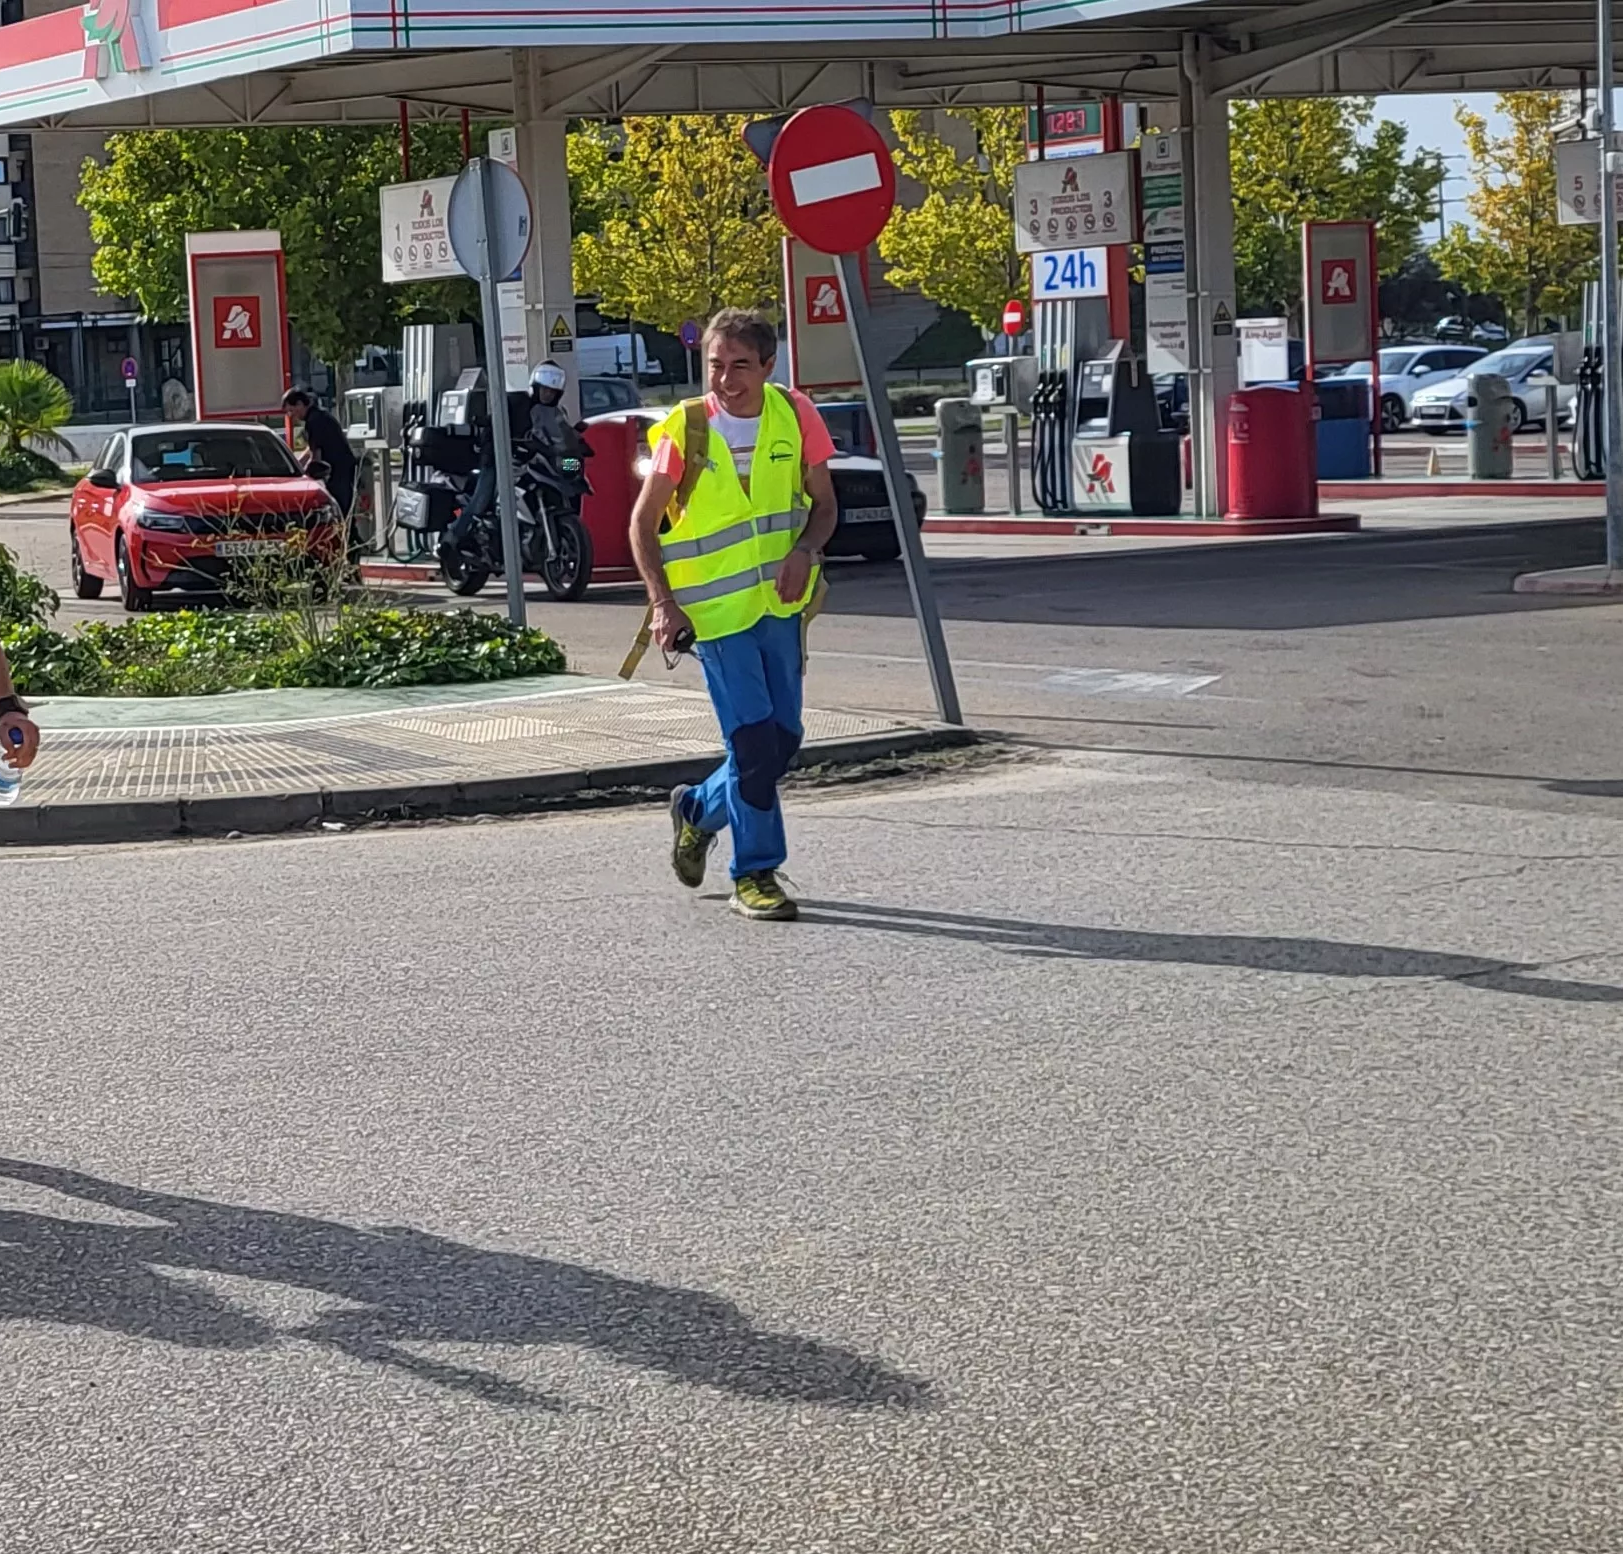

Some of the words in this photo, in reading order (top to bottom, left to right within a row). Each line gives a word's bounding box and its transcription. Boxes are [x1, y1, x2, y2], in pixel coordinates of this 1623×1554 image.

[1574, 175, 1583, 191] 5
[1076, 192, 1091, 202] LOS
[1103, 190, 1113, 208] 3
[1029, 199, 1039, 216] 3
[1050, 203, 1093, 216] PRODUCTOS
[411, 220, 431, 230] TODOS
[432, 217, 444, 228] LOS
[395, 223, 401, 242] 1
[410, 230, 445, 242] PRODUCTOS
[1044, 250, 1096, 292] 24h
